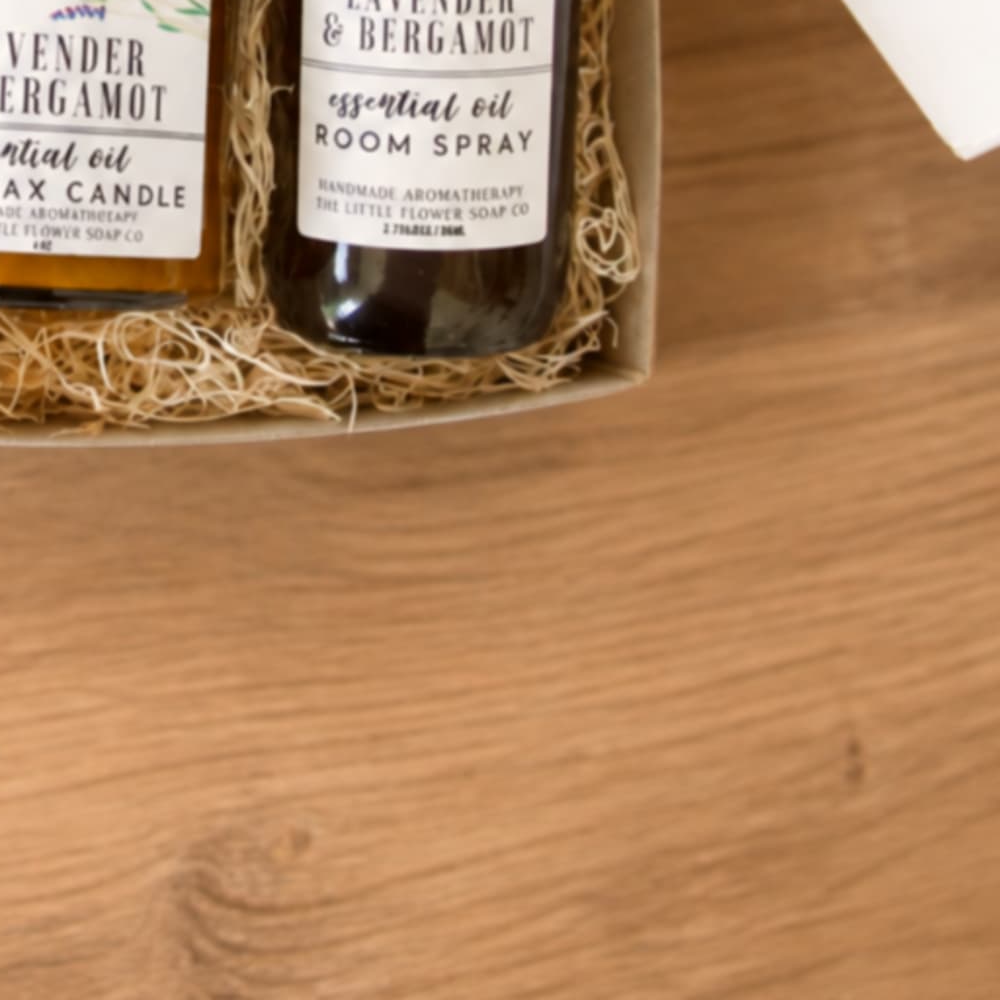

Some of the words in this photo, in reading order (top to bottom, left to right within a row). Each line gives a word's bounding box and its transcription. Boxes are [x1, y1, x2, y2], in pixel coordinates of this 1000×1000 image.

[322, 11, 343, 47] &
[359, 16, 535, 56] BERGAMOT
[328, 89, 460, 122] essential
[471, 90, 514, 120] oil
[315, 123, 412, 156] ROOM
[432, 129, 533, 157] SPRAY
[88, 145, 132, 174] oil
[66, 181, 187, 208] CANDLE
[318, 177, 396, 201] HANDMADE
[403, 184, 524, 203] AROMATHERAPY
[316, 196, 339, 214] THE
[345, 199, 393, 219] LITTLE
[400, 204, 463, 221] FLOWER
[469, 205, 508, 220] SOAP
[512, 202, 530, 216] CO
[24, 224, 82, 239] FLOWER
[85, 227, 122, 241] SOAP
[124, 230, 144, 242] CO
